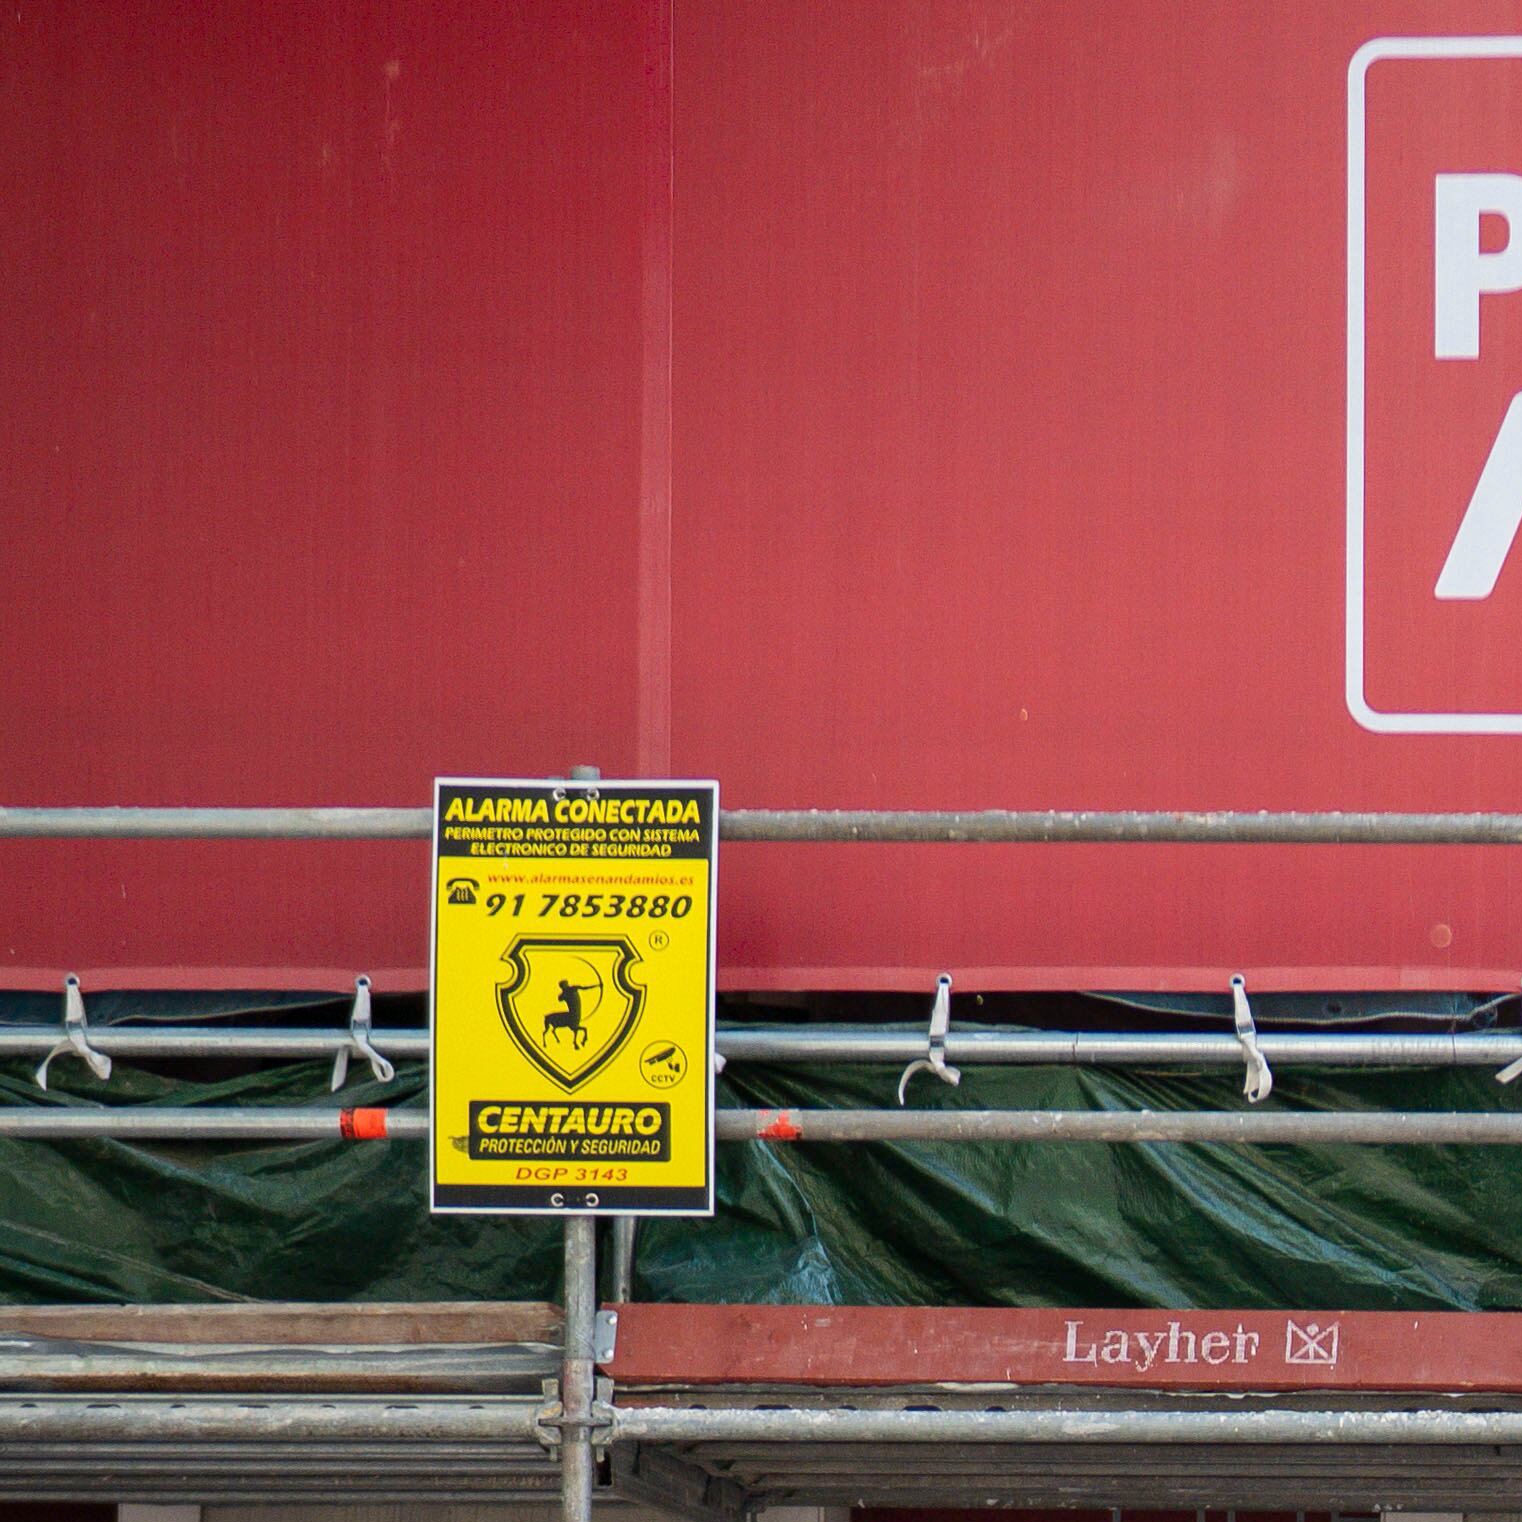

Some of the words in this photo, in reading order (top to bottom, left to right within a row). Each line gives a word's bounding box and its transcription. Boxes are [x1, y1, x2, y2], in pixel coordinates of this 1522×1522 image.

[444, 798, 549, 823] ALARMA
[554, 799, 701, 824] CONECTADA
[445, 827, 524, 841] PERIMETRO
[526, 828, 607, 842] PROTEGIDO
[609, 828, 641, 842] CON
[643, 829, 700, 843] SISTEMA
[470, 842, 568, 856] ELECTRONICO
[569, 843, 589, 857] DE
[591, 844, 672, 857] SEGURIDAD
[487, 873, 694, 886] www.alarmasenandamios.es
[486, 894, 525, 917] 91
[537, 894, 693, 918] 7853880
[651, 1075, 676, 1083] CCTV
[477, 1106, 662, 1135] CENTAURO
[479, 1136, 569, 1154] PROTECCIÓN
[570, 1138, 579, 1154] Y
[581, 1138, 661, 1155] SEGURIDAD
[515, 1167, 568, 1181] DGP
[575, 1168, 629, 1181] 3143
[1062, 1320, 1260, 1372] Layher
